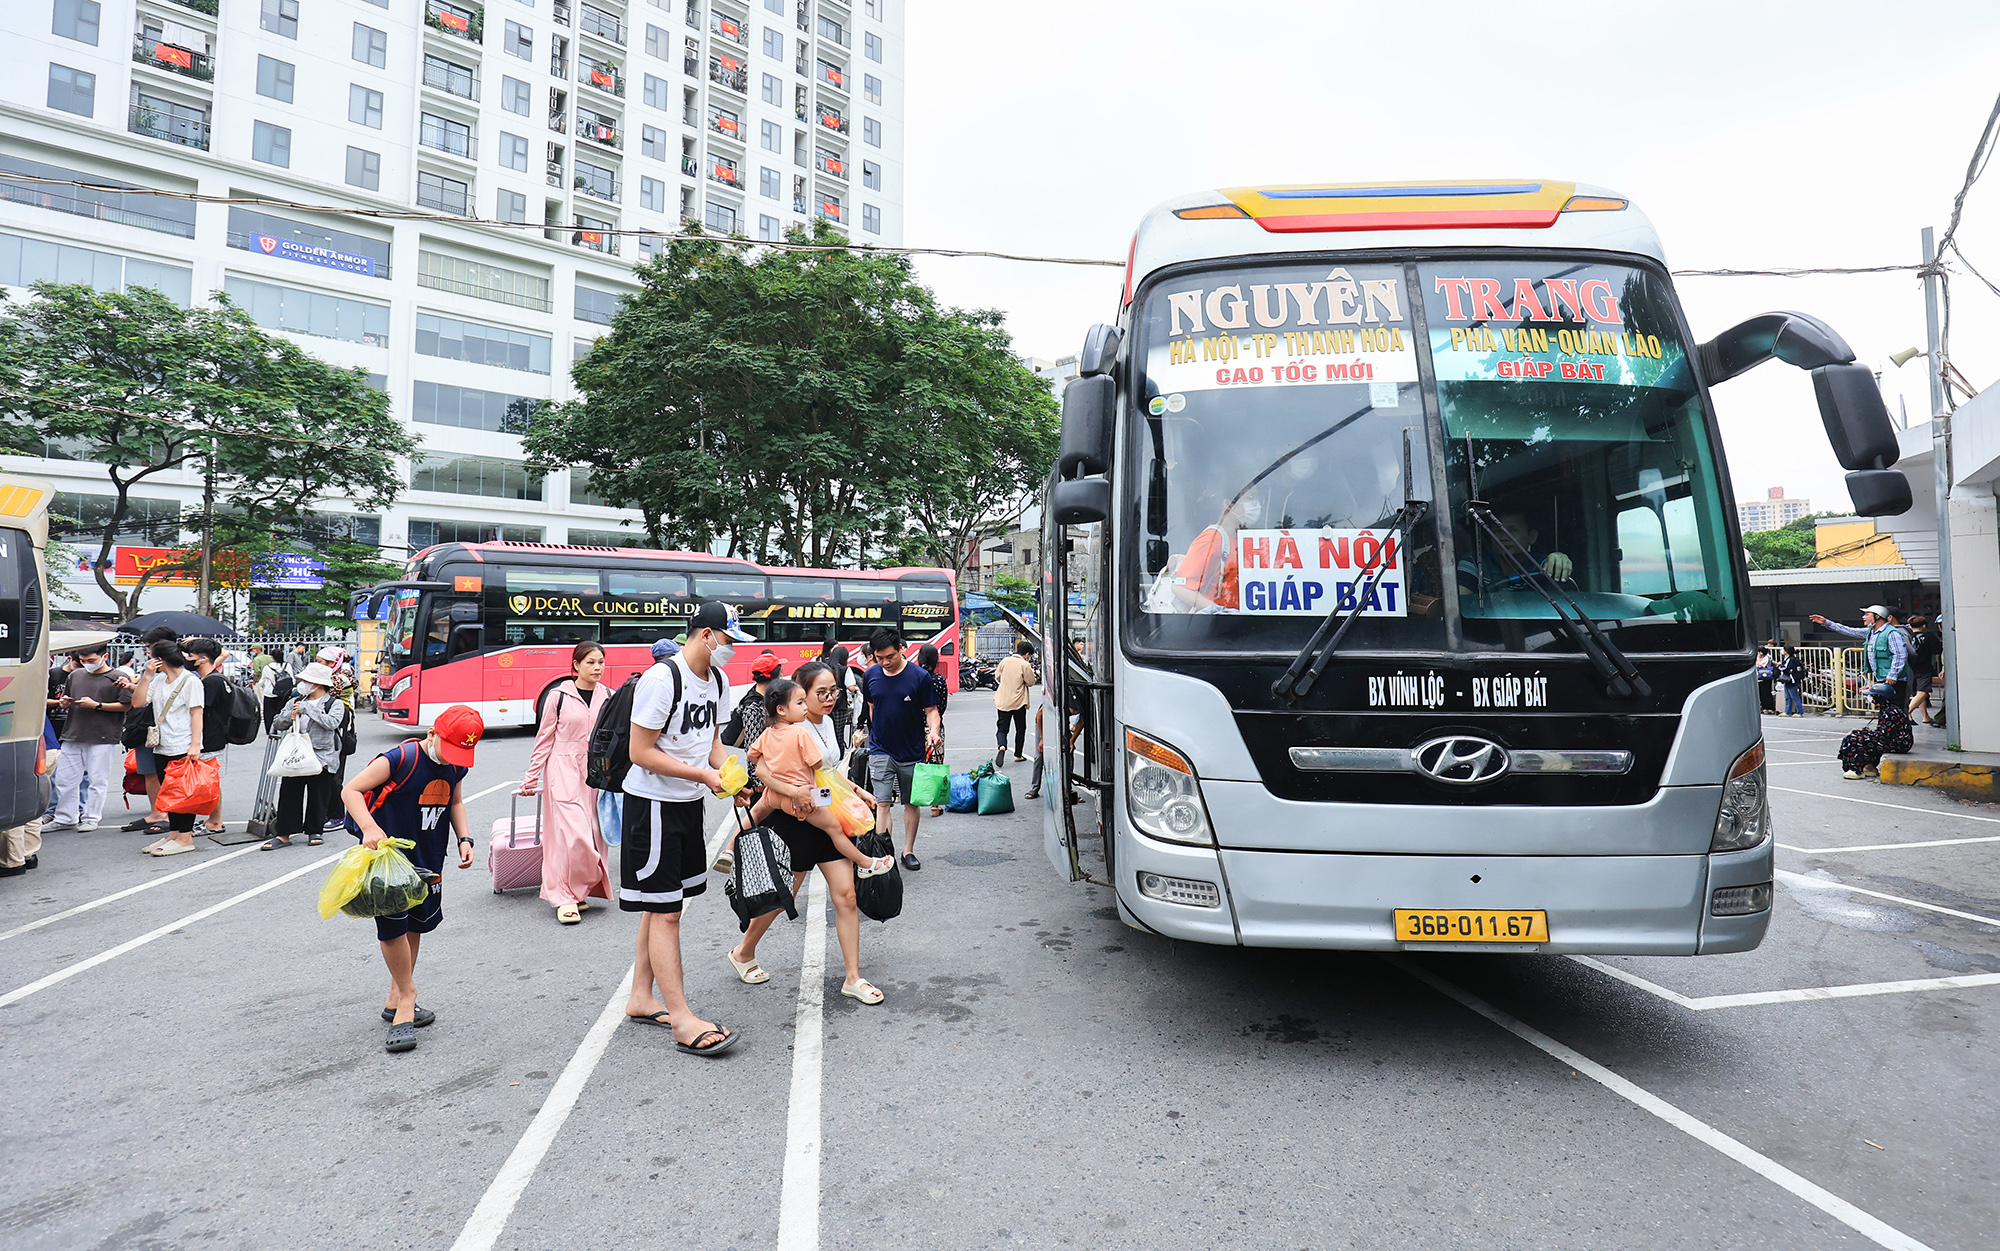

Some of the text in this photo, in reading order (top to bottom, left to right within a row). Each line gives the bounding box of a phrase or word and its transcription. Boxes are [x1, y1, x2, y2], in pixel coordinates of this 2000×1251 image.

[282, 241, 368, 267] GOLDEN ARMOR
[1167, 267, 1404, 337] NGUYÊN
[1434, 275, 1624, 325] TRANG
[1169, 335, 1197, 365] HÀ
[1203, 331, 1238, 364] NỘI
[1284, 329, 1355, 356] THANH
[1361, 323, 1404, 352] HÓA
[1450, 322, 1498, 352] PHÀ
[1622, 329, 1663, 360] LÀO
[1216, 358, 1374, 385] CAO TỐC MỚI
[1496, 357, 1606, 381] GIÁP BÁT
[1242, 530, 1397, 576] HÀ NỘI
[534, 597, 584, 614] DCAR
[1245, 574, 1400, 612] GIÁP BÁT
[593, 602, 639, 614] CUNG
[644, 599, 679, 616] ĐIỆN
[844, 606, 882, 619] LAN
[1368, 676, 1386, 706] BX
[1388, 670, 1418, 706] VĨNH
[1421, 670, 1445, 709] LỘC
[1472, 677, 1490, 707] BX
[1492, 672, 1521, 707] GIÁP
[1524, 670, 1547, 707] BÁT
[420, 806, 446, 831] W
[1408, 915, 1533, 936] 36B-011.67
